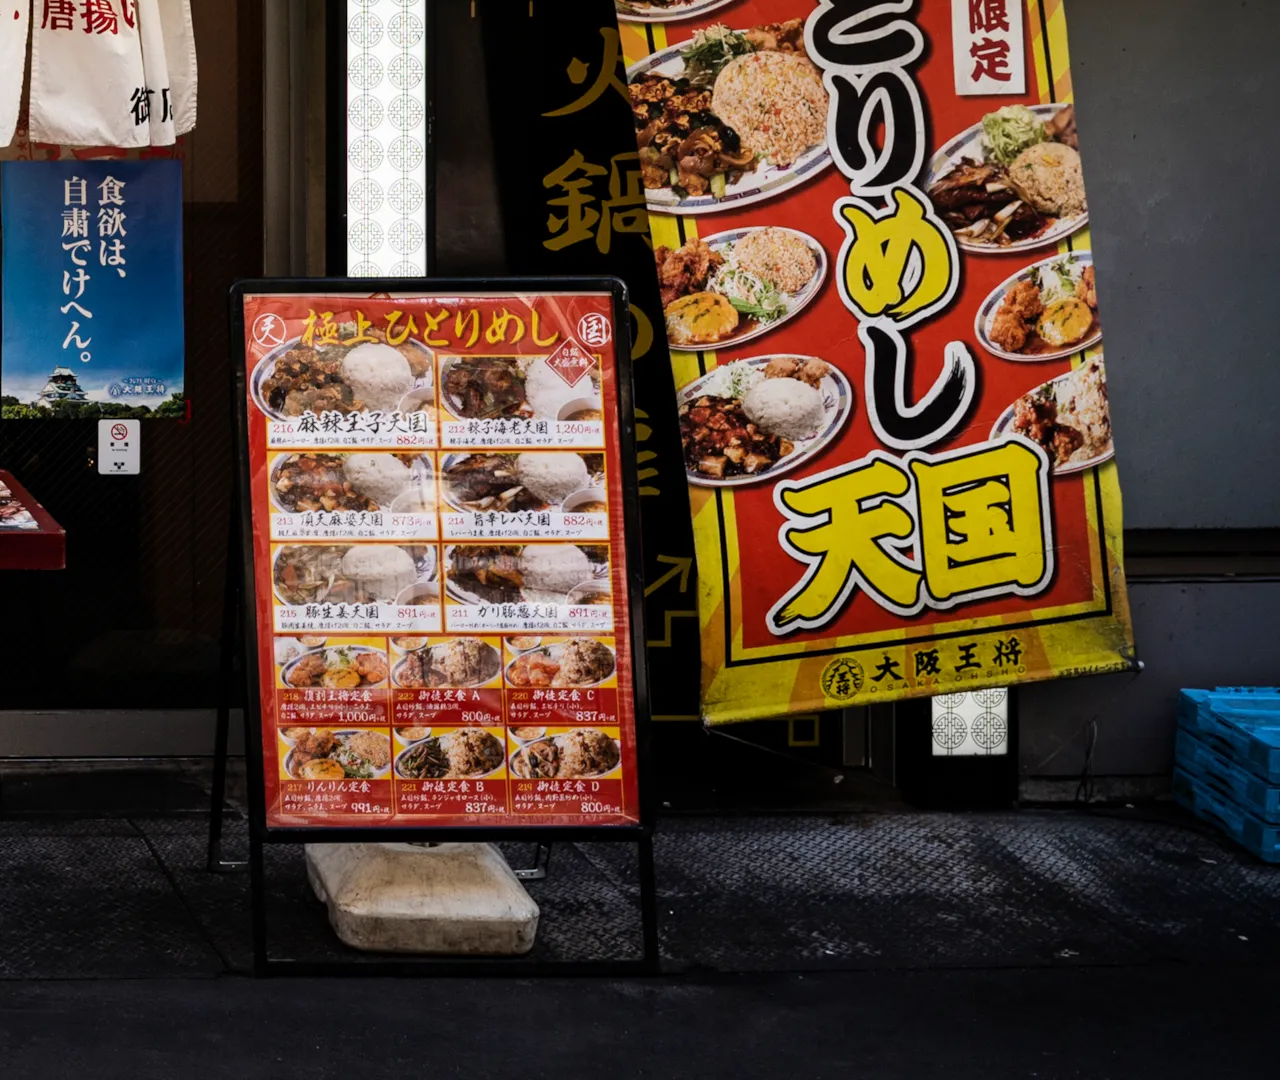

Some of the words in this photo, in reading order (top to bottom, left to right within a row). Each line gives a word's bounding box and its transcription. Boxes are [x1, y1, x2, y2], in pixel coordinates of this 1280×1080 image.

[96, 175, 128, 279] 食欲は、
[59, 175, 93, 364] 自粛でけへん。
[301, 307, 560, 349] 極上ひとりめし
[123, 384, 167, 395] 大阪王将
[273, 423, 294, 434] 216
[297, 411, 428, 434] 麻辣玉子天国
[448, 424, 465, 434] 212
[467, 420, 549, 435] 辣子海老天国
[277, 517, 294, 527] 213
[301, 513, 384, 527] 頂天麻婆天国
[447, 517, 465, 526] 214
[473, 512, 551, 527] 旨辛レバ天国
[766, 434, 1053, 636] 天国
[280, 609, 297, 618] 215
[305, 605, 379, 619] 豚生姜天国
[451, 609, 469, 618] 211
[477, 605, 558, 619] ガリ豚葱天国
[869, 636, 1024, 683] 大阪王将
[870, 677, 941, 694] OSAKA
[954, 665, 1027, 683] OHSHO
[283, 692, 300, 701] 218
[397, 692, 414, 702] 222
[418, 689, 468, 702] 御徒定食
[471, 690, 481, 701] A
[512, 692, 529, 700] 220
[532, 689, 581, 701] 御徒定食
[586, 690, 595, 700] C
[287, 784, 302, 792] 217
[306, 781, 371, 793] りんりん定食
[401, 784, 417, 792] 221
[422, 781, 470, 793] 御徒定食
[476, 782, 484, 792] B
[517, 783, 533, 792] 219
[536, 781, 585, 793] 御徒定食
[591, 781, 600, 791] D
